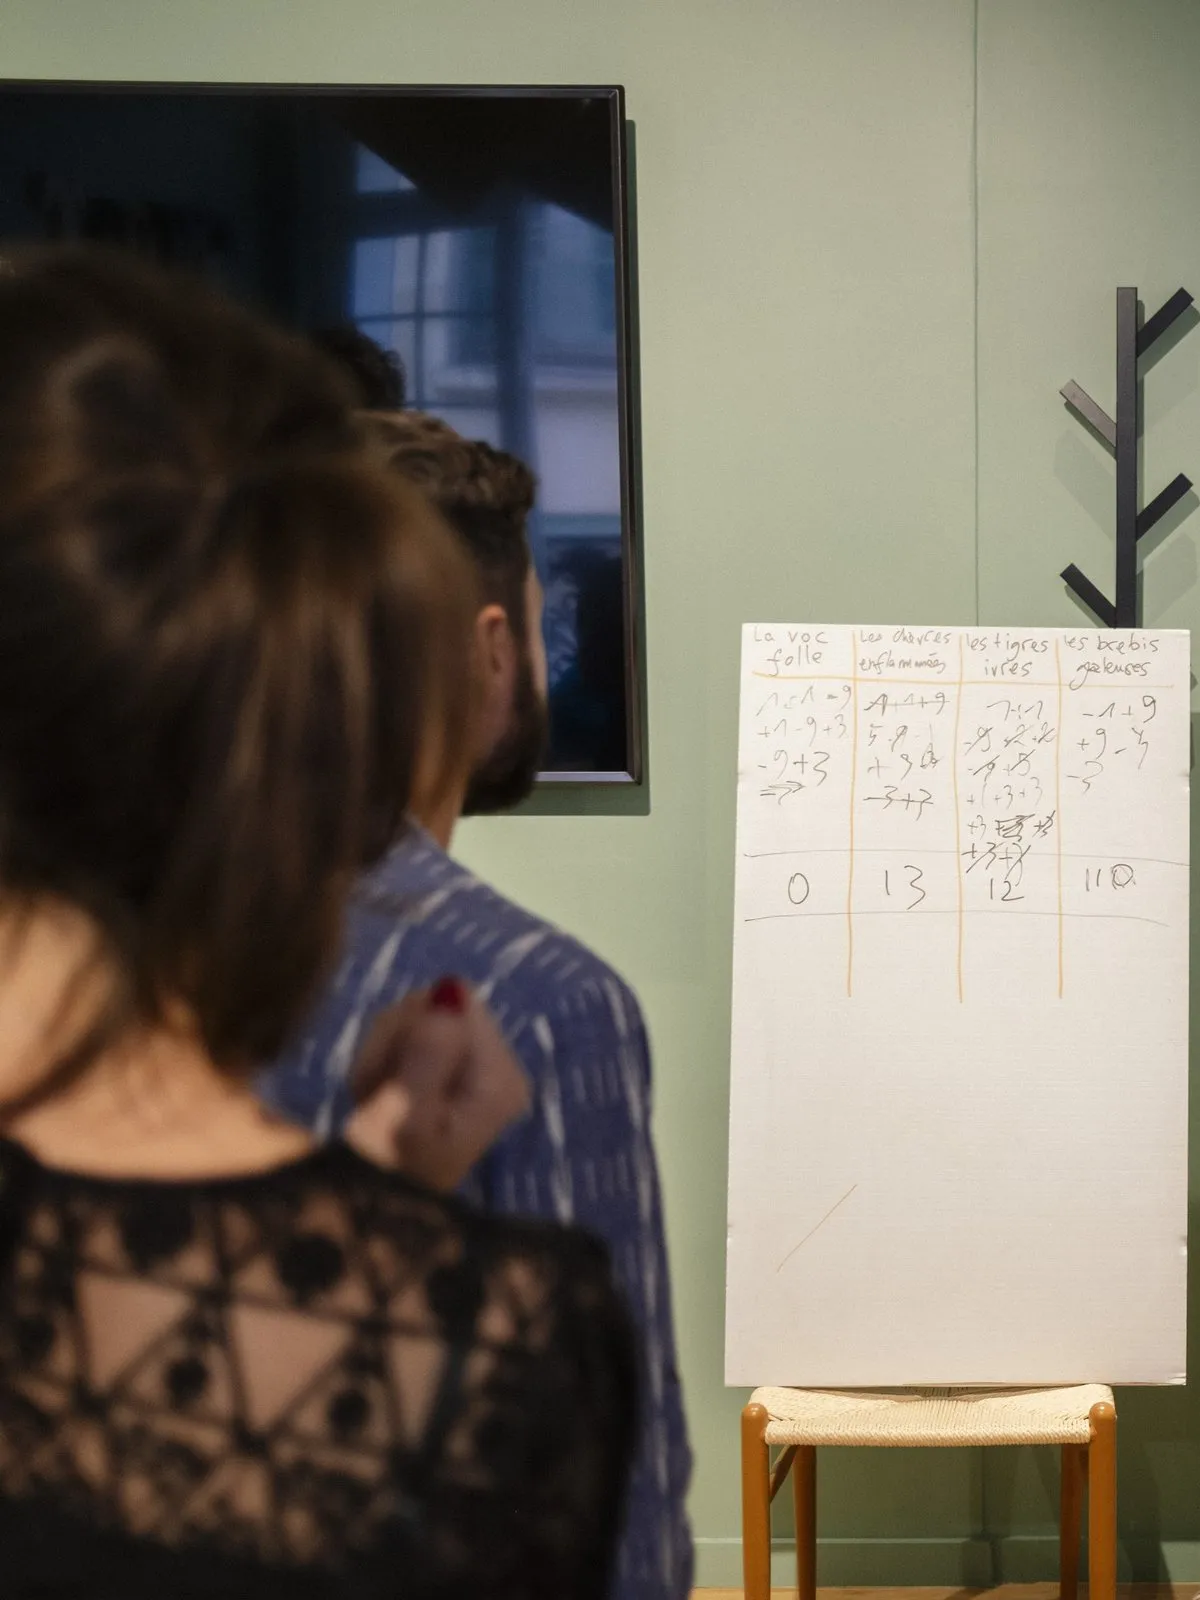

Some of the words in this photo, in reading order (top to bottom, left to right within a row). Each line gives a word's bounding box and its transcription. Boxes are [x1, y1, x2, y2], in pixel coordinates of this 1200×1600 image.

[754, 631, 775, 642] La
[993, 633, 1048, 662] tigres
[1097, 633, 1159, 654] brebis
[766, 645, 822, 677] folle
[984, 658, 1032, 677] ivres
[788, 872, 810, 904] 0
[885, 865, 926, 910] 13
[990, 878, 1025, 902] 12
